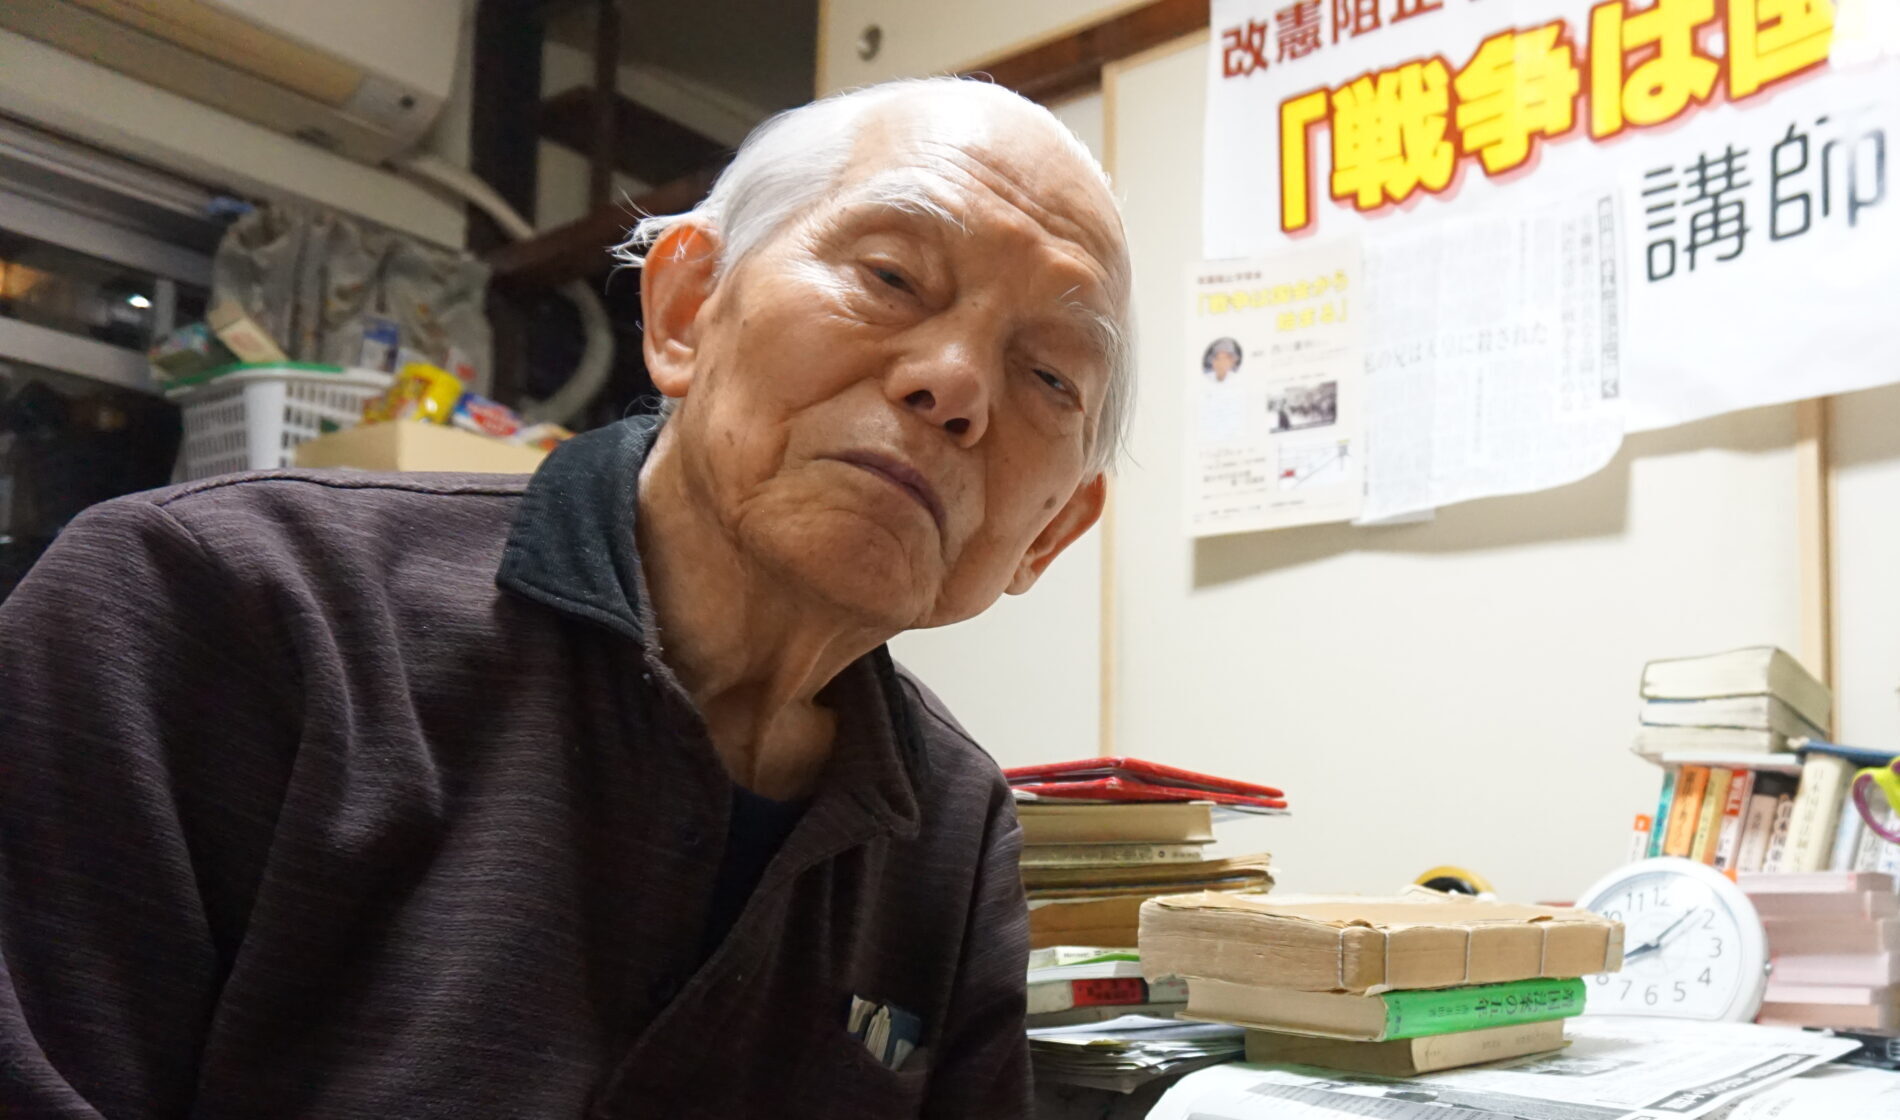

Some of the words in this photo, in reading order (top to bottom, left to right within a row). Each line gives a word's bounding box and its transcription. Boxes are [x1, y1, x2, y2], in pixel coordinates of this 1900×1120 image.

[1641, 104, 1887, 283] 講師
[1627, 893, 1644, 912] 11
[1702, 909, 1715, 930] 2
[1709, 937, 1722, 958] 3
[1697, 967, 1712, 986] 4
[1620, 980, 1632, 1001] 7
[1645, 985, 1658, 1005] 6
[1673, 981, 1686, 1002] 5
